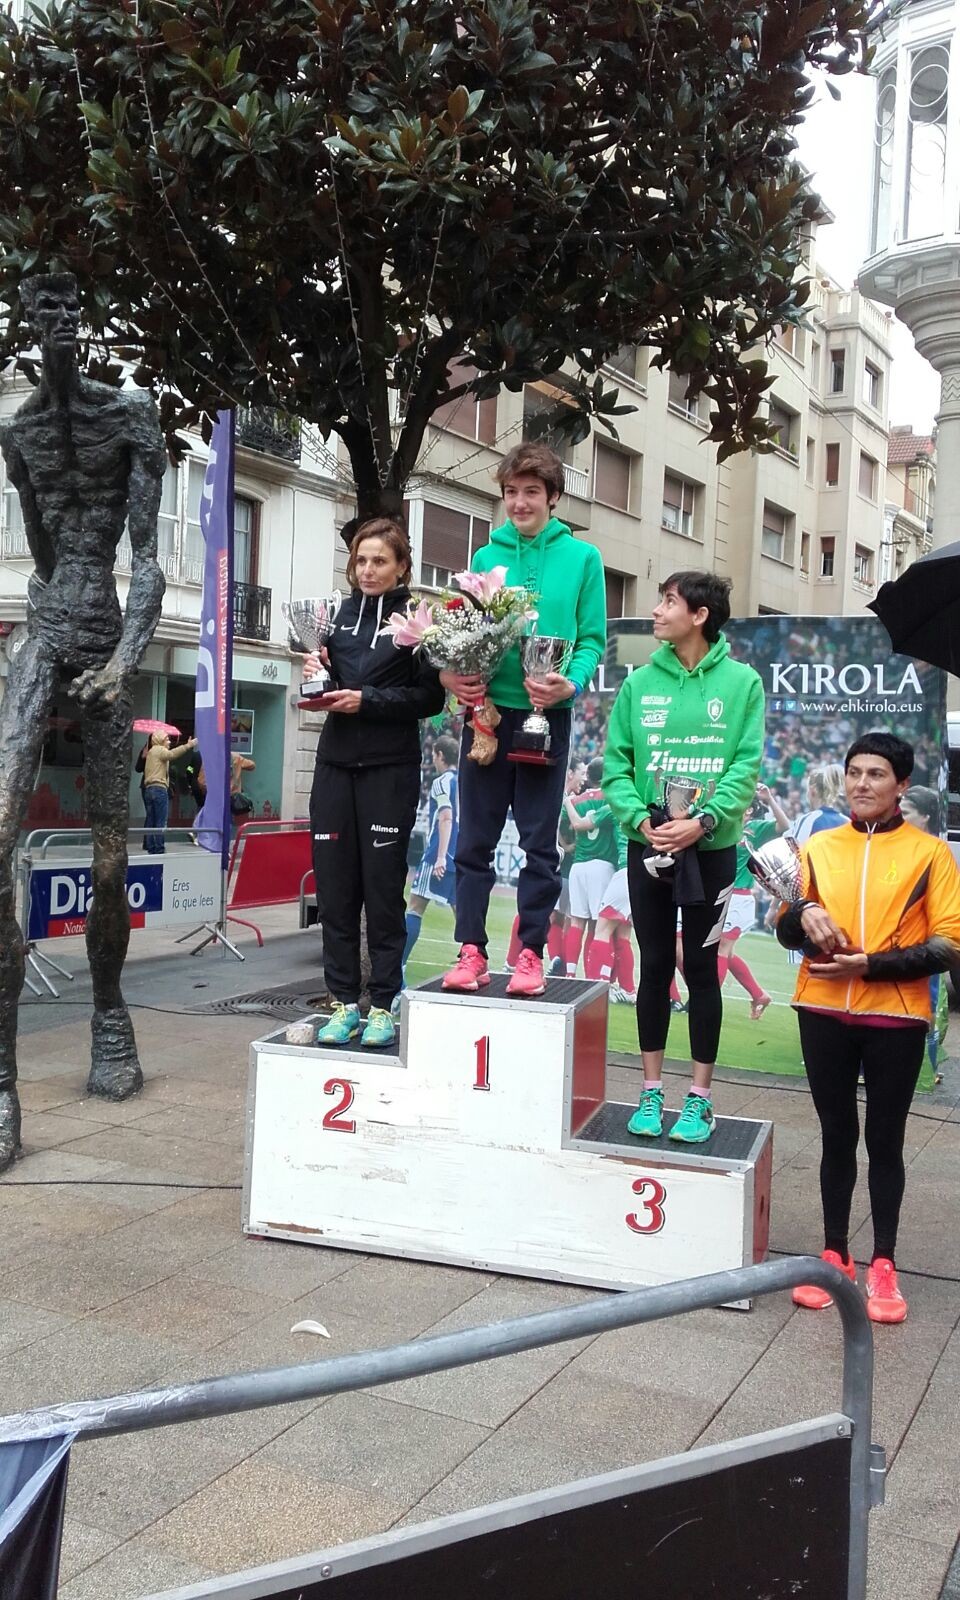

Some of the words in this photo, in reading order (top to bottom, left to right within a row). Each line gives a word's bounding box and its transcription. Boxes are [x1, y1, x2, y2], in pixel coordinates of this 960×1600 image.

[262, 662, 278, 680] edp
[769, 662, 923, 695] KIROLA
[800, 699, 923, 713] www.ehkirola.eus
[645, 749, 725, 773] Zirauna
[370, 823, 399, 834] Alimco
[49, 873, 146, 916] Diao
[172, 878, 190, 892] Eres
[172, 896, 180, 909] lo
[182, 898, 198, 911] que
[199, 893, 214, 907] lees
[62, 920, 86, 936] Notic
[473, 1035, 491, 1091] 1
[322, 1077, 357, 1134] 2
[624, 1177, 667, 1235] 3
